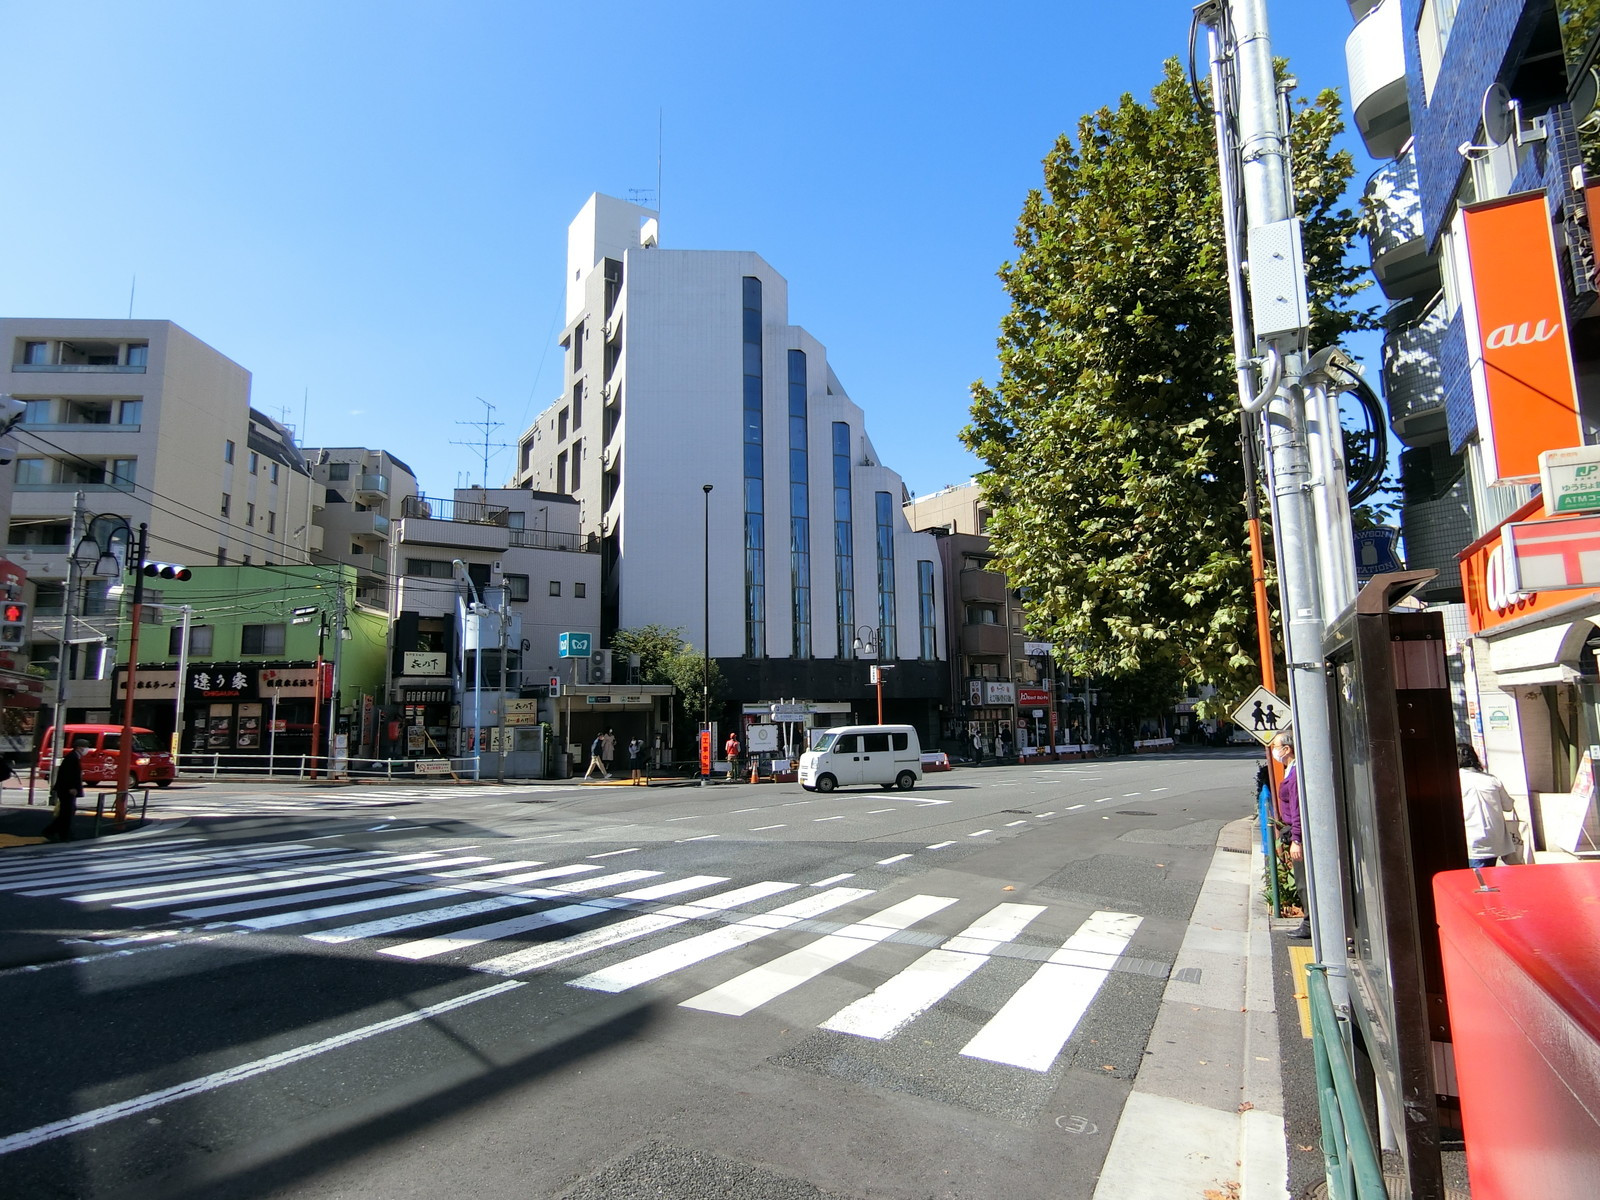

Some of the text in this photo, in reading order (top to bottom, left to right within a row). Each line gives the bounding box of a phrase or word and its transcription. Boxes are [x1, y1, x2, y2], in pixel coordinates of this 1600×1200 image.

[1486, 319, 1560, 349] au
[1577, 465, 1598, 477] JP
[1354, 531, 1391, 541] AWSON
[1357, 561, 1393, 573] TATION
[193, 672, 248, 690] 違う家
